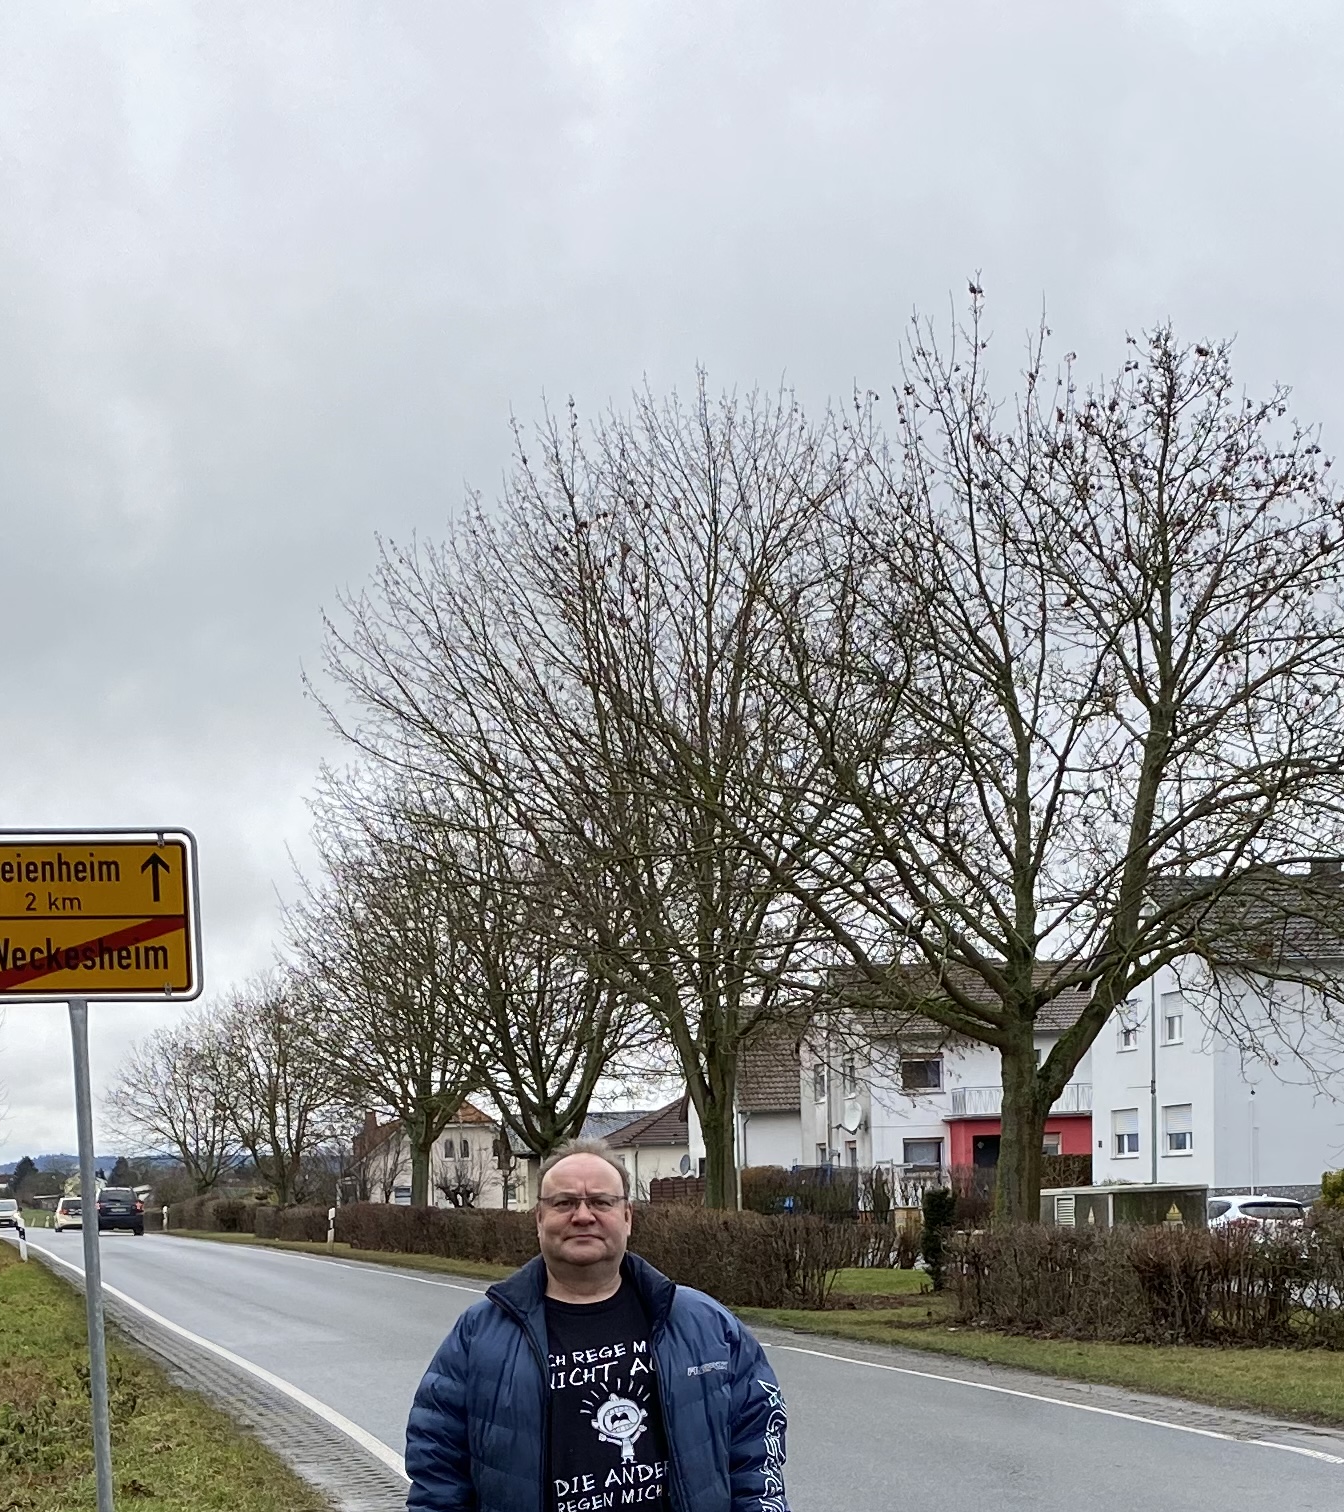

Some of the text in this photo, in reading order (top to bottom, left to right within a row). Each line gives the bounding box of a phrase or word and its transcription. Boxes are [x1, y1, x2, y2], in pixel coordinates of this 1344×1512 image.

[25, 891, 82, 912] 2 km
[572, 1342, 626, 1364] REGE
[554, 1473, 596, 1497] DIE
[621, 1484, 664, 1504] MICH
